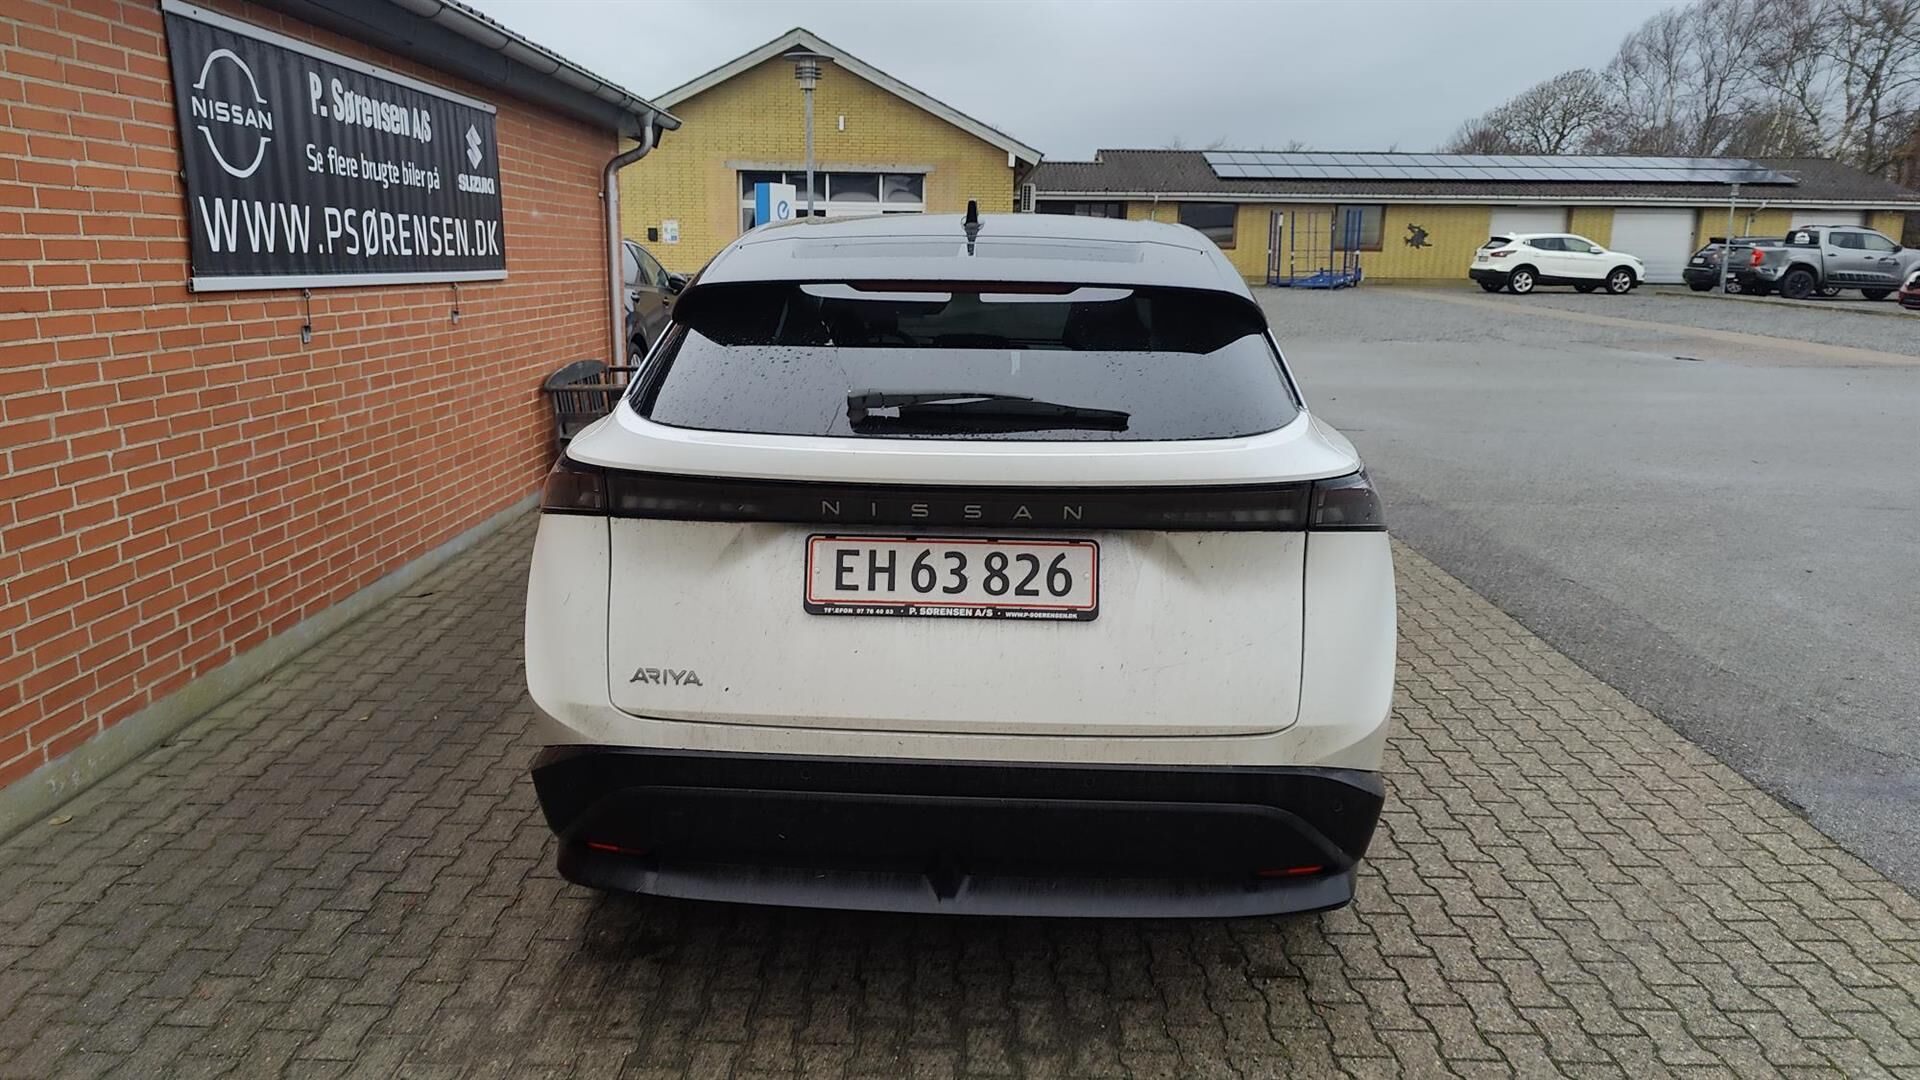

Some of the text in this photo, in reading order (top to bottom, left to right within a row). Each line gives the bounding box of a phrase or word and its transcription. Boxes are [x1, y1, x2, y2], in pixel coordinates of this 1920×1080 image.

[192, 96, 272, 130] NISSAN
[308, 72, 432, 143] P. Sørensen A/S
[306, 143, 440, 194] Se flere brugte biler på
[458, 173, 495, 195] SUZUKI
[199, 196, 500, 258] WWW.PSØRENSEN.DK
[822, 501, 1082, 520] NISSAN
[835, 548, 1073, 597] EH 63 826
[909, 607, 918, 615] P.
[919, 607, 972, 616] SØRENSEN
[974, 608, 993, 617] A/S
[629, 667, 703, 686] ARIYA
